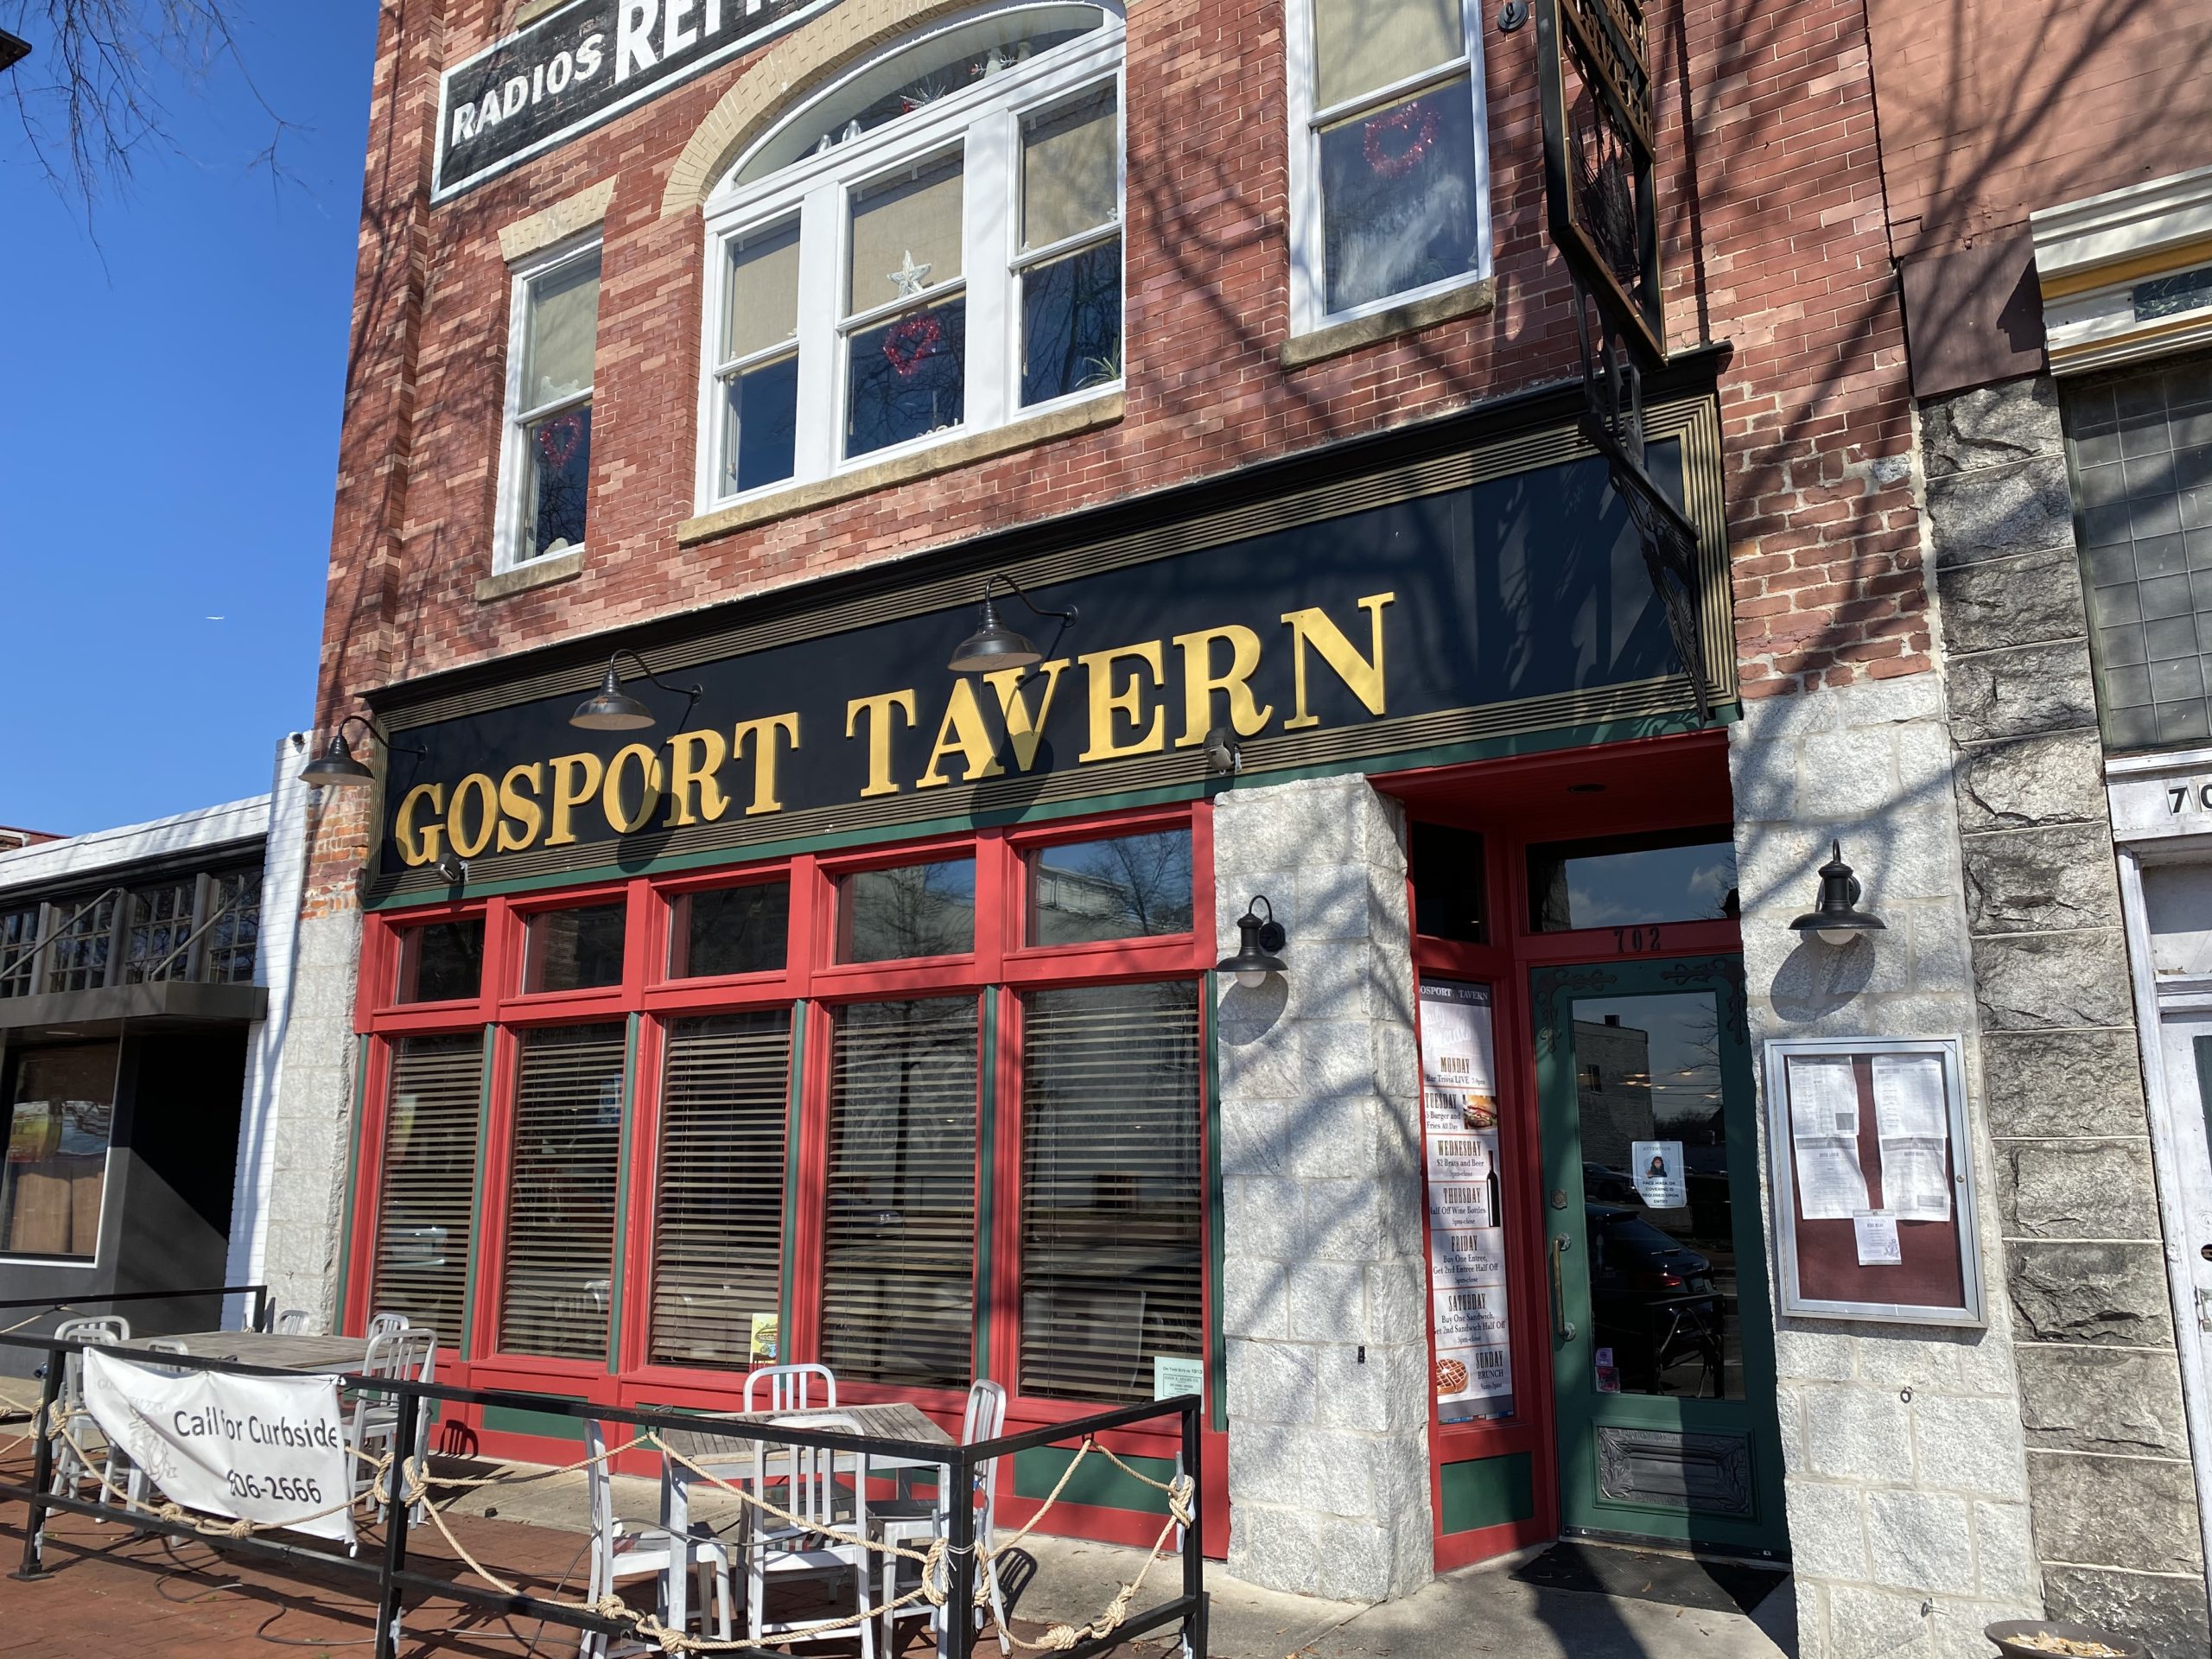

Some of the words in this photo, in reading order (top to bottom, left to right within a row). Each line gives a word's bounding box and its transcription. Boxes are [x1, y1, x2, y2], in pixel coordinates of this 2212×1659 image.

[451, 33, 605, 148] RADIOS
[395, 711, 799, 868] GOSPORT
[845, 591, 1395, 798] TAVERN
[1612, 925, 1661, 954] 702
[1420, 985, 1452, 997] OSPORT
[1458, 988, 1489, 1001] TAVERN
[1440, 1057, 1470, 1074] MONDAY
[1426, 1074, 1436, 1083] Bar
[1437, 1074, 1454, 1084] Trivia
[1454, 1075, 1469, 1084] LIVE
[1425, 1092, 1457, 1109] TUESDAY
[1430, 1111, 1450, 1122] Burger
[1449, 1122, 1459, 1132] Day
[1438, 1140, 1482, 1157] WEDNESDAY
[1436, 1158, 1444, 1167] $2
[1444, 1159, 1459, 1167] Brats
[1471, 1159, 1484, 1167] Beer
[1443, 1187, 1481, 1205] THURSDAY
[1441, 1206, 1452, 1215] Off
[1452, 1206, 1466, 1215] Wine
[1467, 1205, 1486, 1214] Bottles
[1452, 1235, 1478, 1252] FRIDAY
[1443, 1255, 1454, 1265] Buy
[1455, 1254, 1467, 1262] One
[1433, 1266, 1444, 1274] Get
[1444, 1265, 1455, 1274] 2nd
[1456, 1264, 1475, 1274] Entree
[1475, 1262, 1488, 1272] Half
[1489, 1262, 1498, 1272] Off
[1448, 1293, 1486, 1312] SATURDAY
[1441, 1314, 1452, 1325] Buy
[1453, 1313, 1466, 1323] One
[1443, 1325, 1454, 1334] 2nd
[1454, 1323, 1481, 1333] Sandwich
[1482, 1321, 1495, 1331] Half
[1496, 1320, 1505, 1329] Off
[1476, 1351, 1503, 1369] SUNDAY
[1478, 1369, 1503, 1380] BRUNCH
[174, 1406, 219, 1437] Call
[249, 1415, 338, 1449] Curbside
